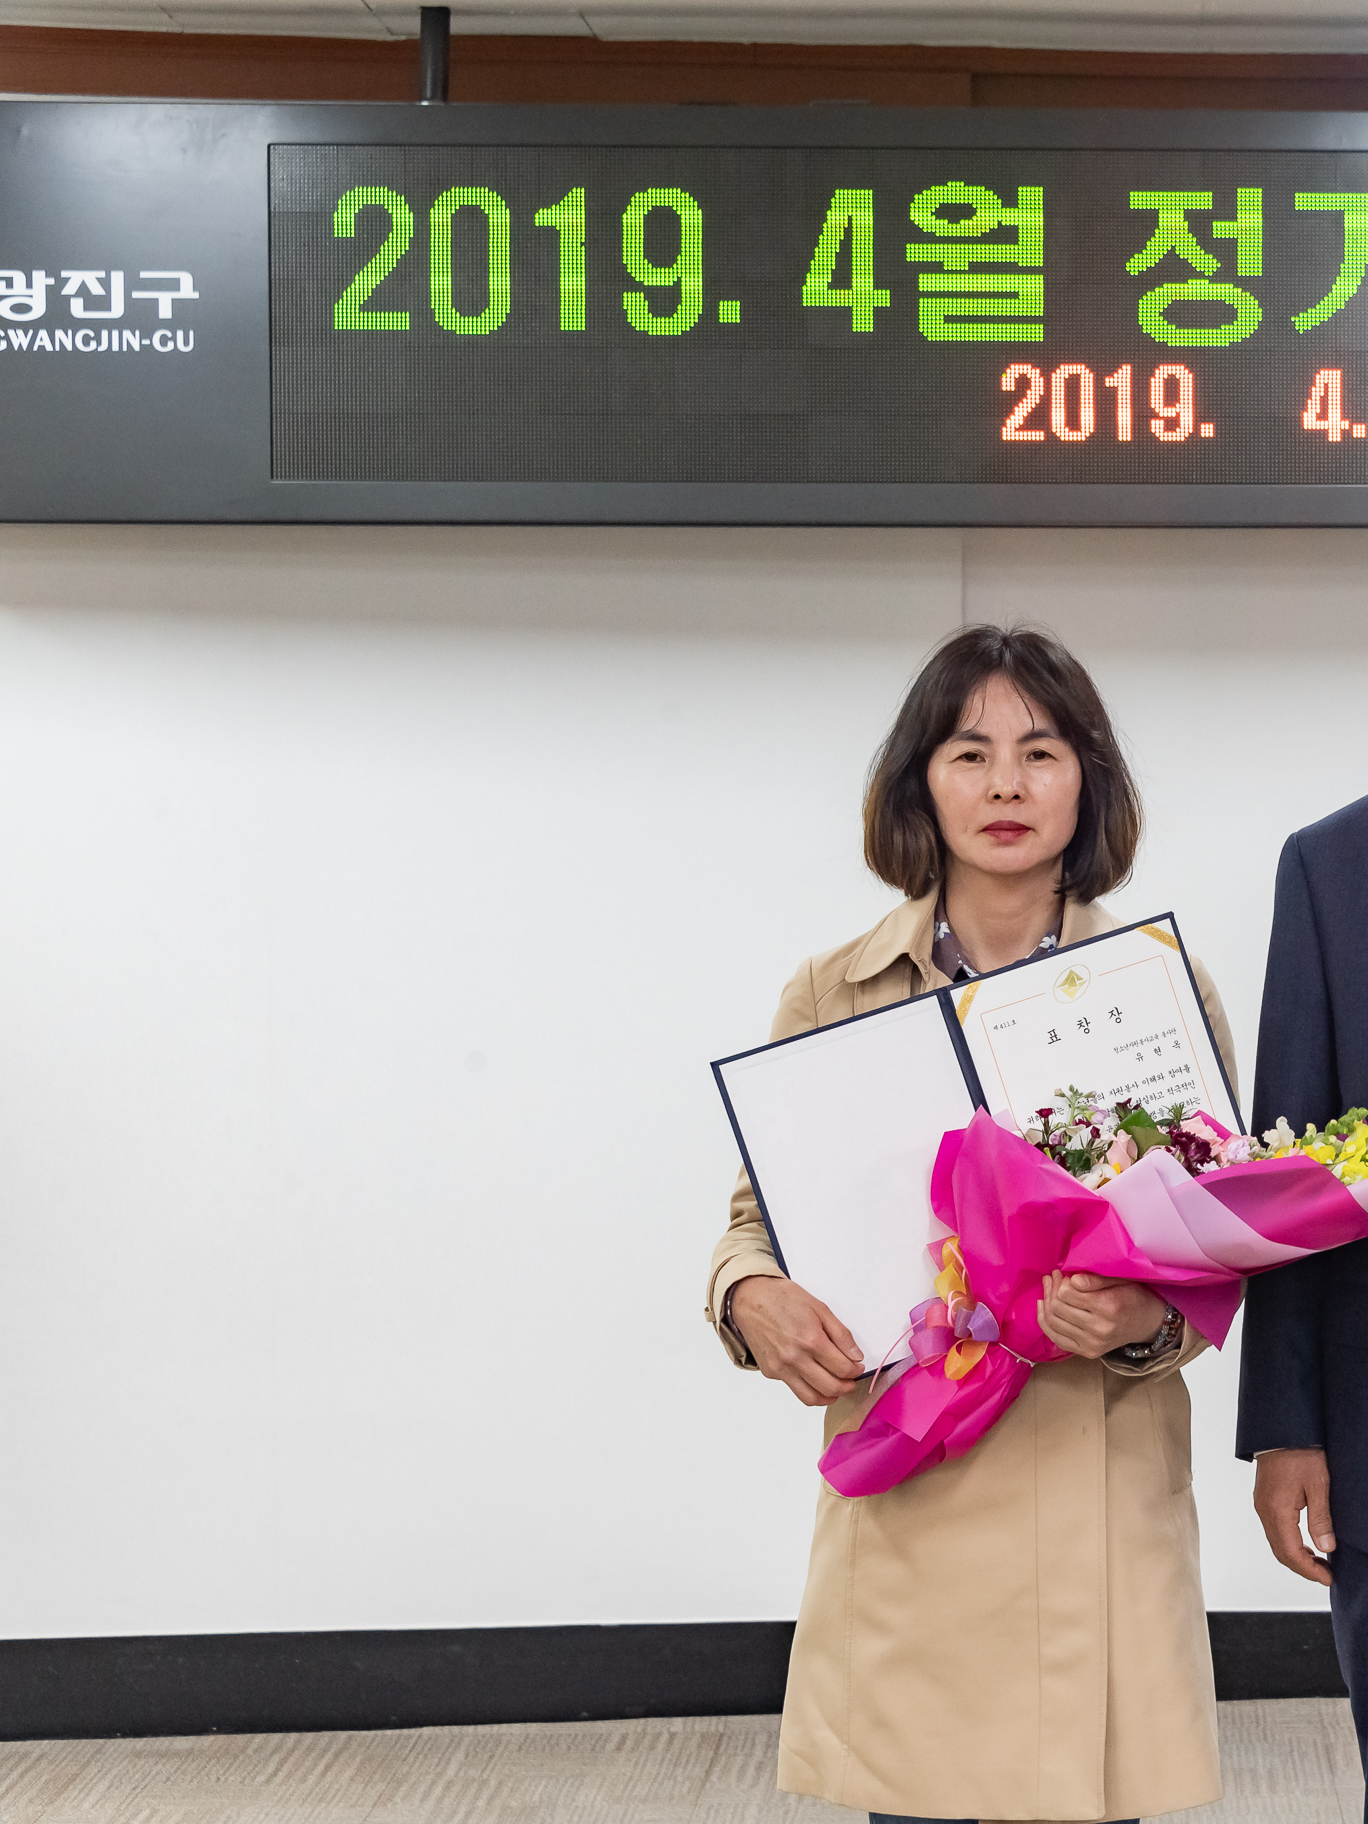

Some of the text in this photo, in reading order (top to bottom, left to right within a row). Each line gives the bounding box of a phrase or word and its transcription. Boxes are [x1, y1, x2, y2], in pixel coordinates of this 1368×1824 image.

[332, 186, 741, 336] 2019.
[801, 181, 1045, 343] 4월
[0, 270, 200, 321] 광진구
[1000, 362, 1216, 443] 2019.
[1300, 365, 1368, 443] 4.
[1108, 1081, 1140, 1097] 자원봉사
[1168, 1063, 1191, 1079] 참여를
[1167, 1079, 1196, 1096] 적극적인
